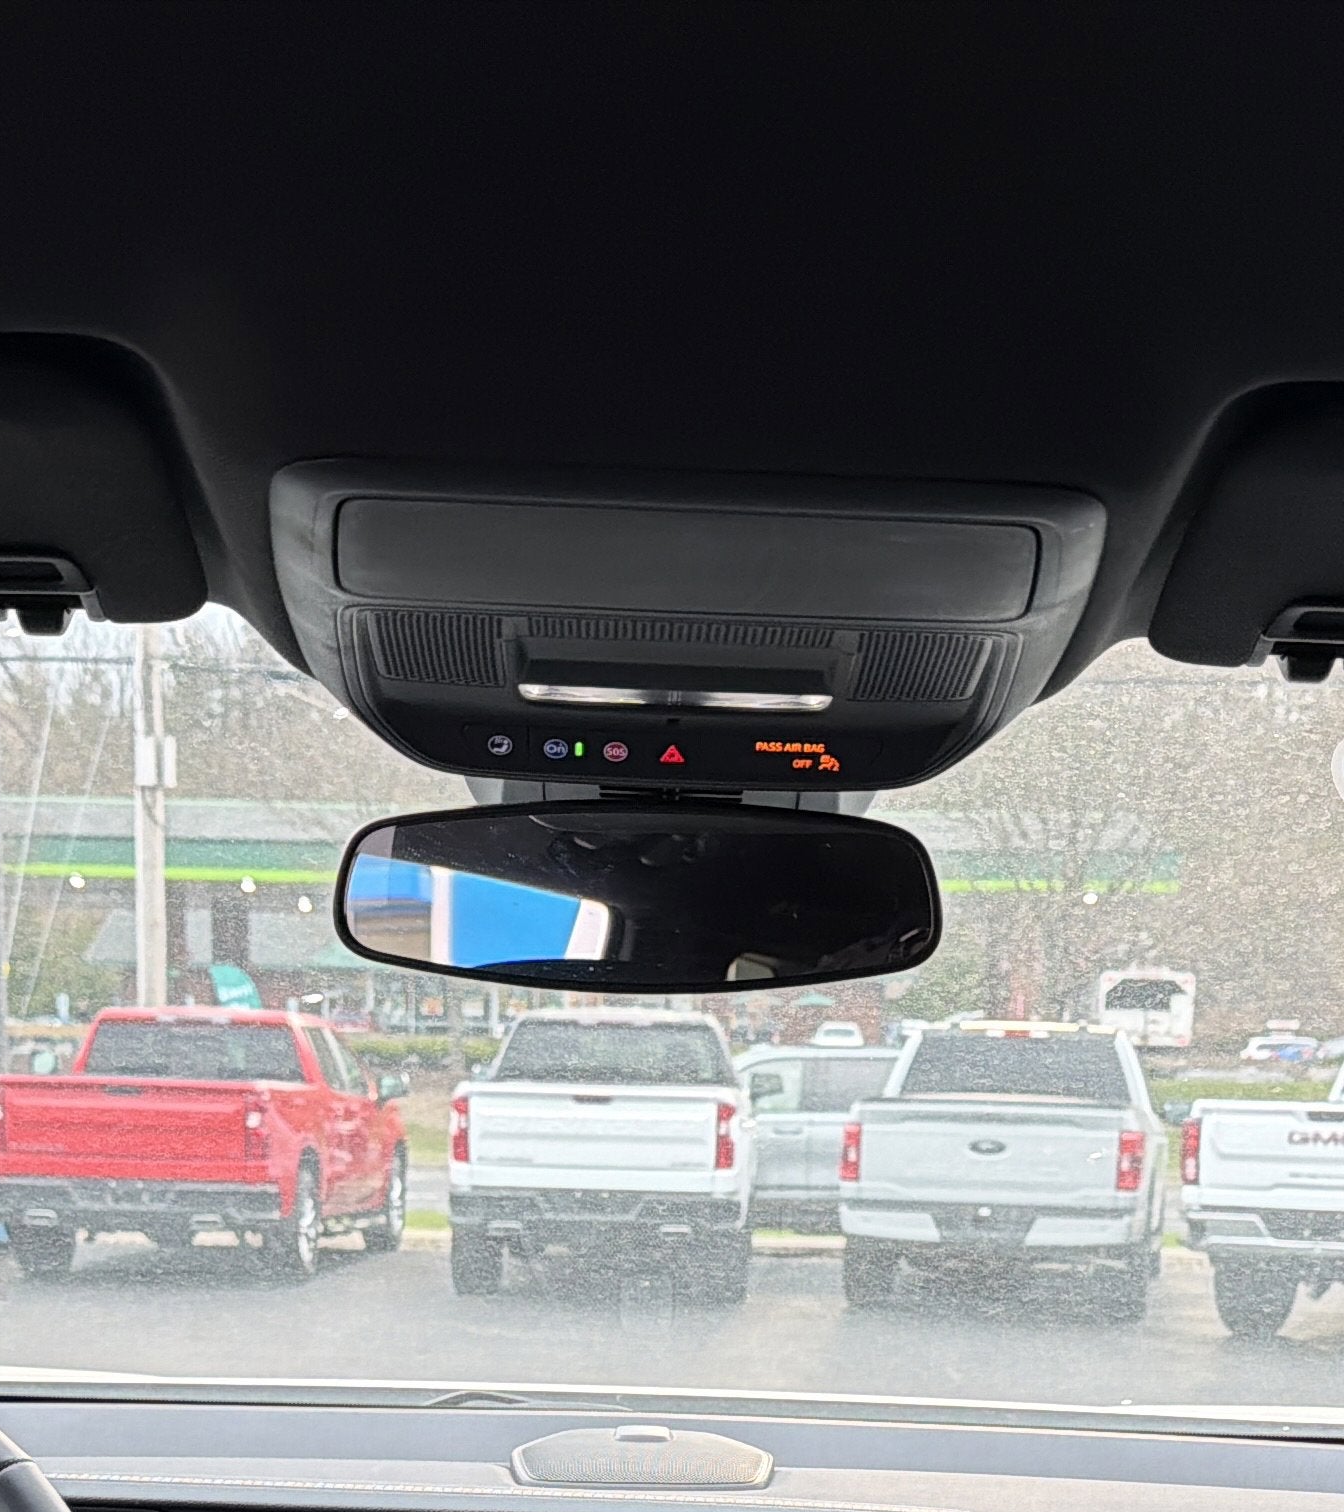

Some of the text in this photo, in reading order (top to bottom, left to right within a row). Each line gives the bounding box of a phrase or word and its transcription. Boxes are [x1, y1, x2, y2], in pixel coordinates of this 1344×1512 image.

[605, 748, 626, 757] SOS
[755, 742, 826, 754] PASS AIR BAG
[792, 759, 813, 769] OFF
